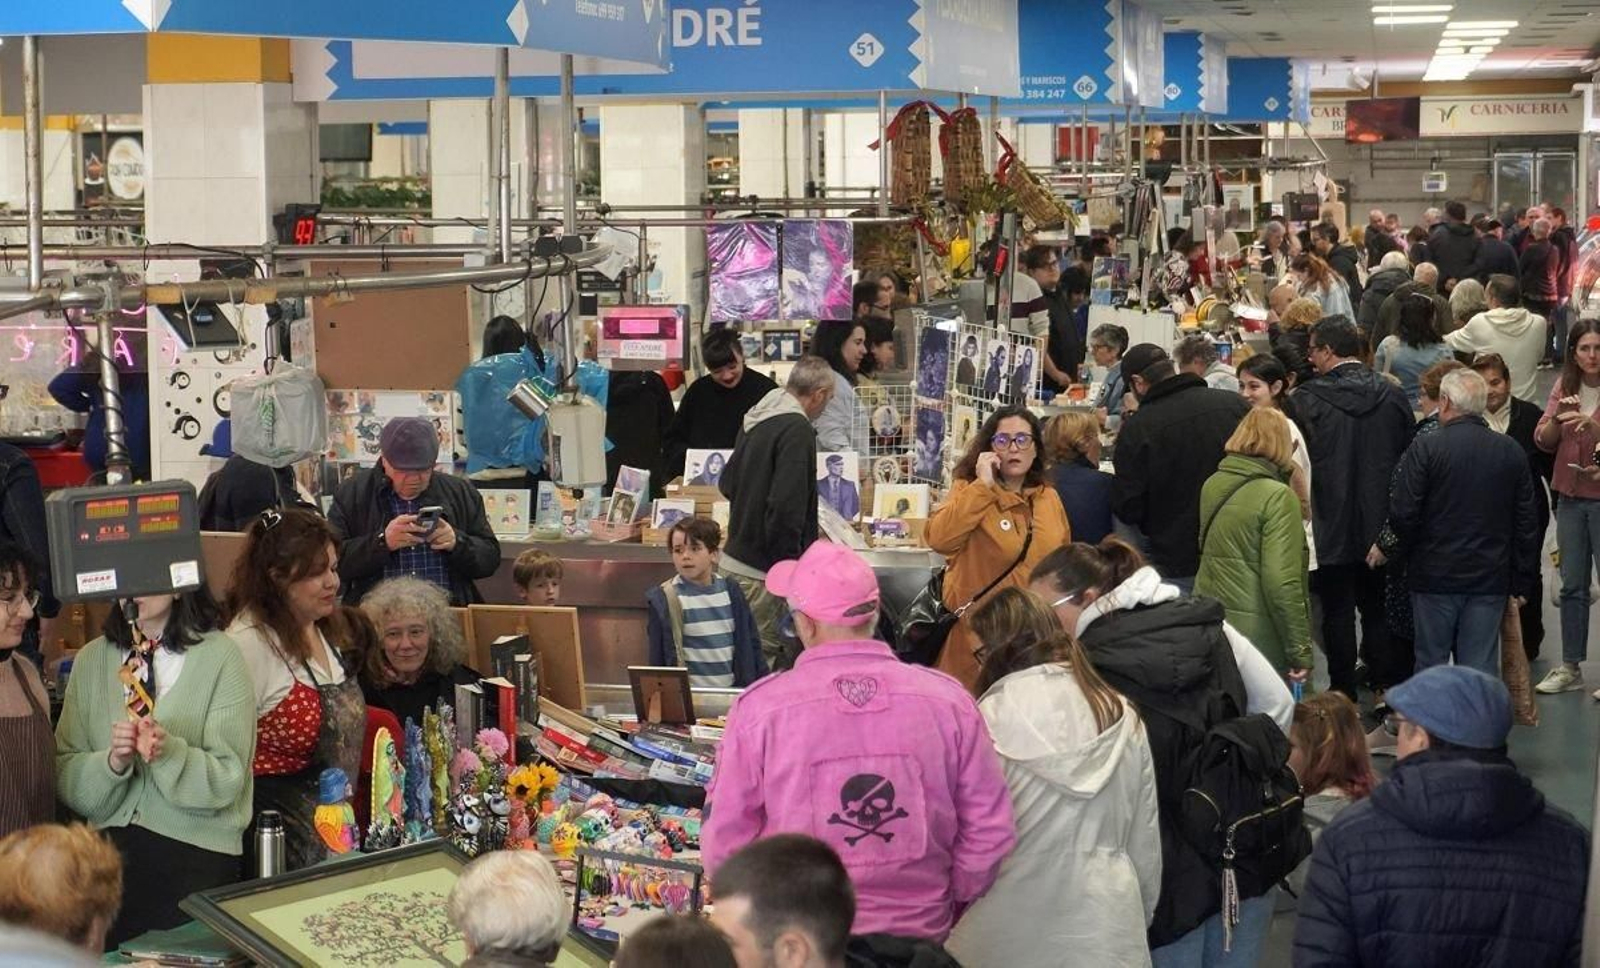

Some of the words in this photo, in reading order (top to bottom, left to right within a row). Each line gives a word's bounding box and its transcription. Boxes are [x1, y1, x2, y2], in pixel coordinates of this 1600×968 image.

[672, 0, 763, 47] DRÉ
[856, 42, 875, 56] 51
[1077, 82, 1093, 92] 66
[1046, 89, 1066, 98] 247
